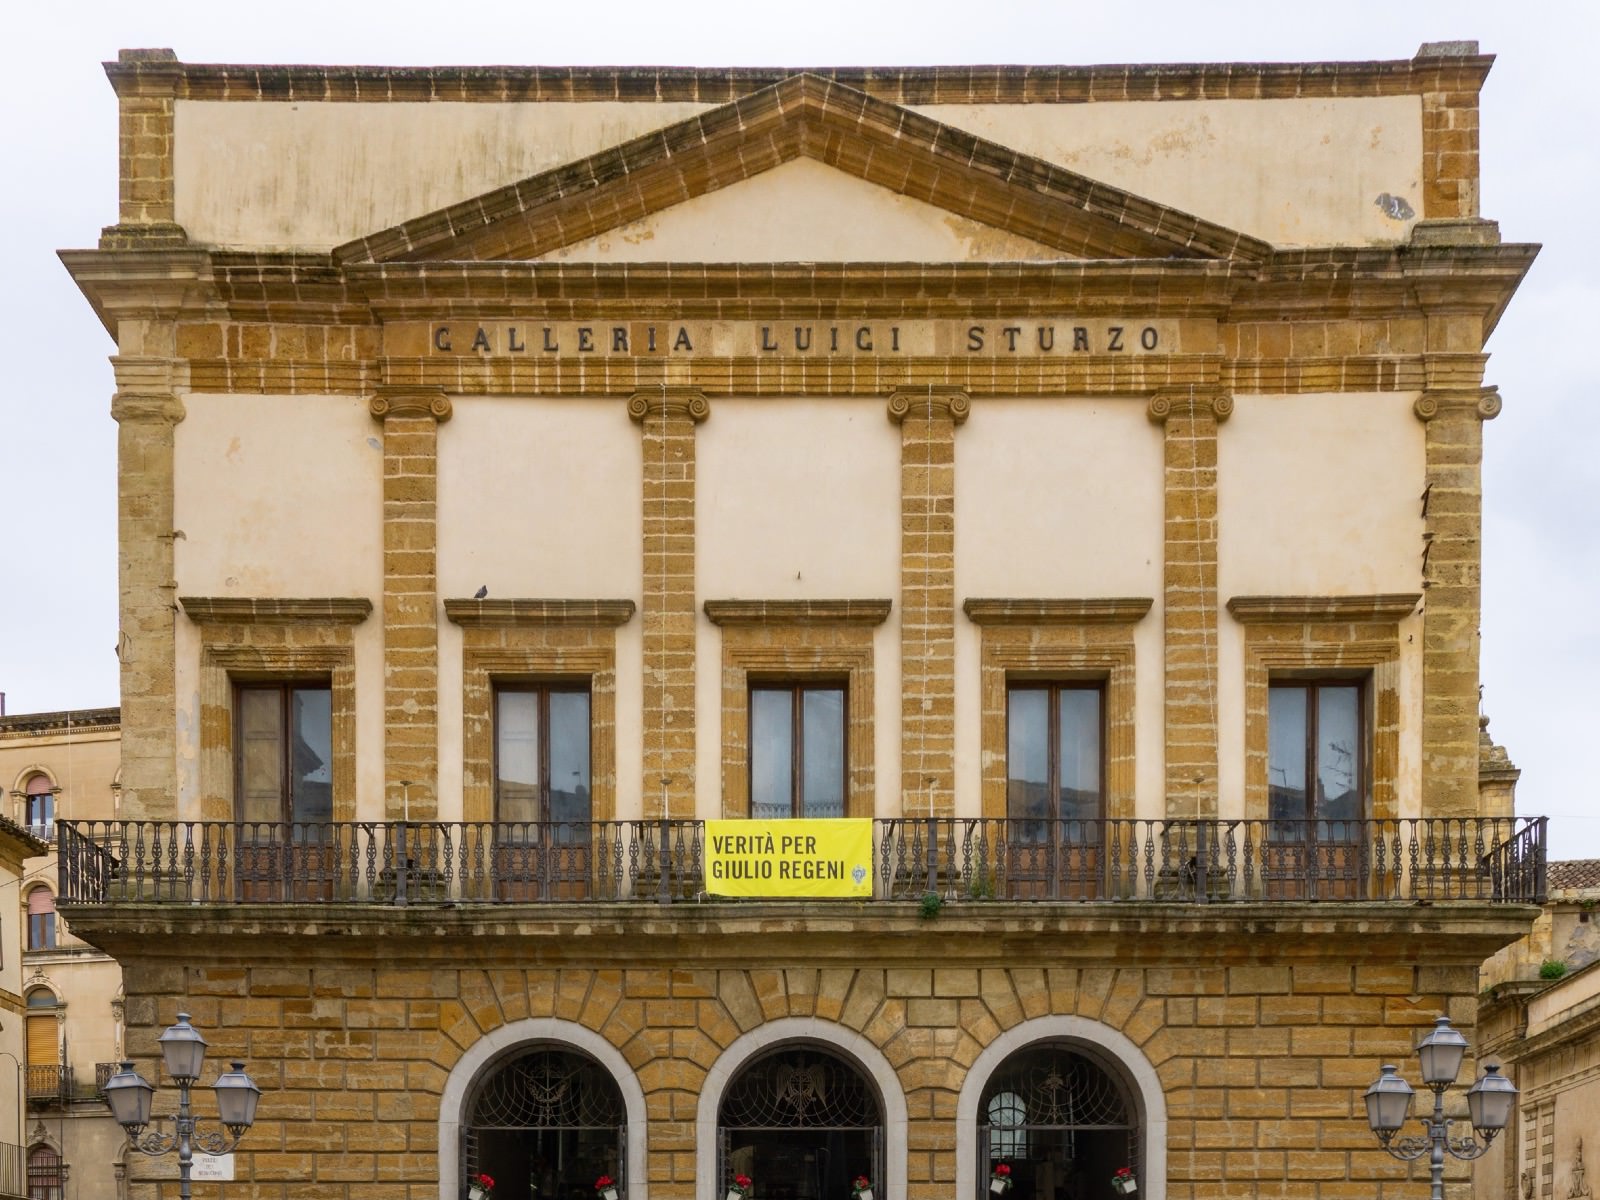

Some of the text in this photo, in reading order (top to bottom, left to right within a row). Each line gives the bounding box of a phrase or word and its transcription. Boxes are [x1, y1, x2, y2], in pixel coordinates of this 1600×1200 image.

[434, 326, 1159, 351] GALLERIA LUIGI STURZO
[712, 832, 817, 854] VERITÀ PER
[712, 860, 845, 880] GIULIO REGENI
